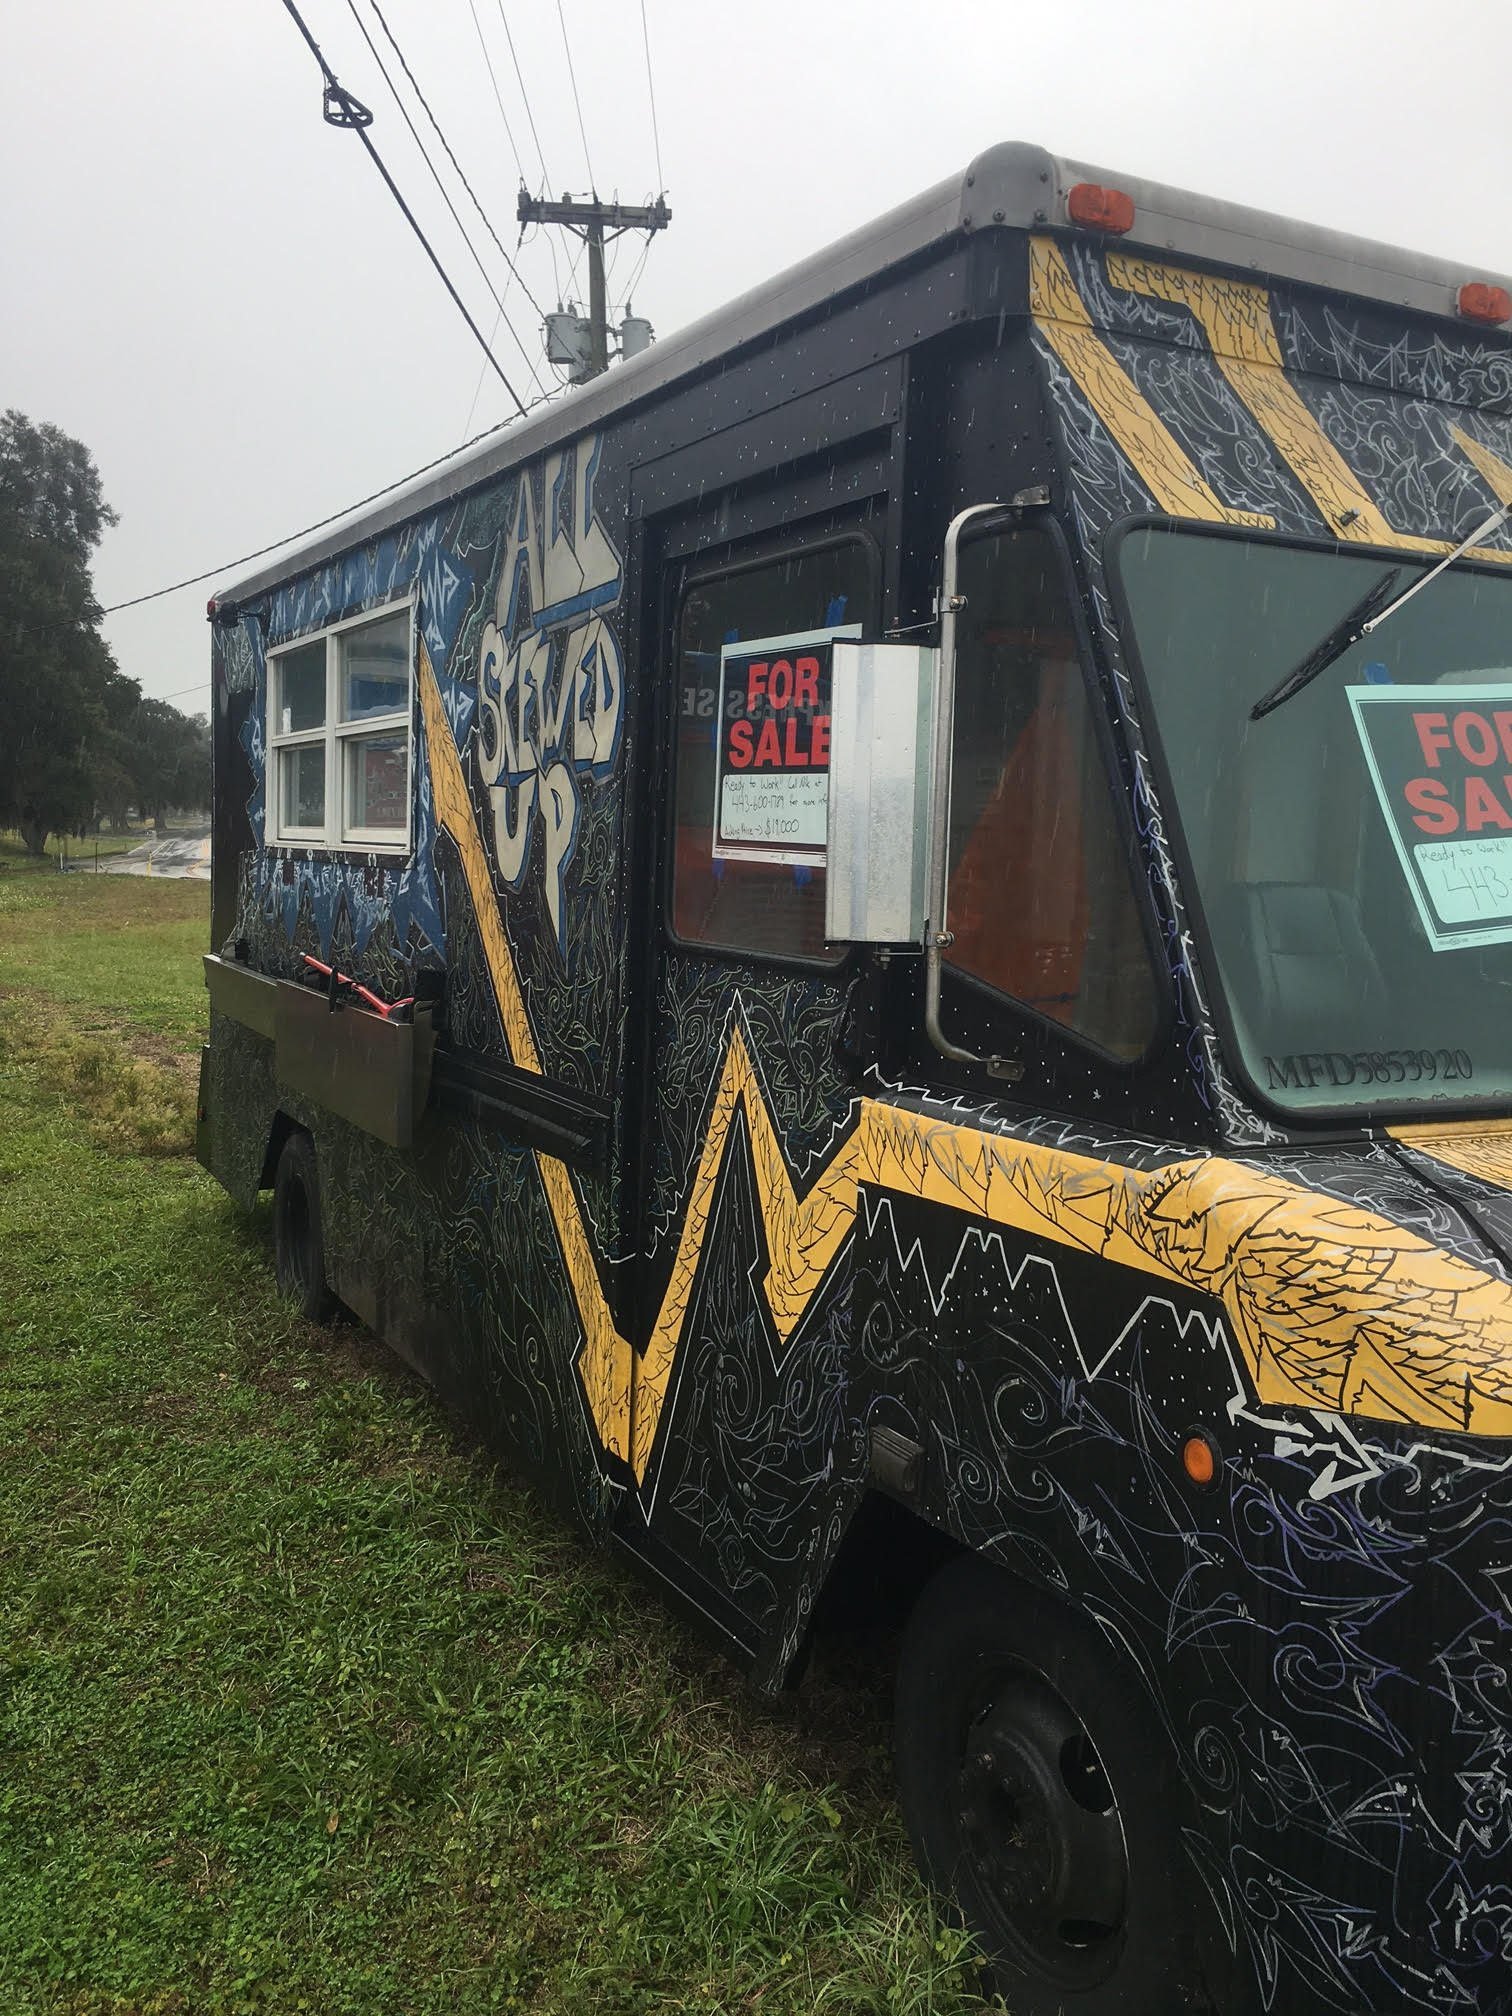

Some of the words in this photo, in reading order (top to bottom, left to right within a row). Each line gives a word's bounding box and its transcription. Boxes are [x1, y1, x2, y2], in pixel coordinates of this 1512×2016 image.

[495, 433, 622, 632] ALL
[478, 609, 624, 787] SKEWED
[747, 656, 820, 712] FOR
[728, 715, 831, 768] SALE
[749, 776, 756, 788] to
[489, 762, 578, 956] UP
[1419, 843, 1456, 870] Ready
[1460, 843, 1473, 856] to
[1263, 1049, 1473, 1090] MFD5853920
